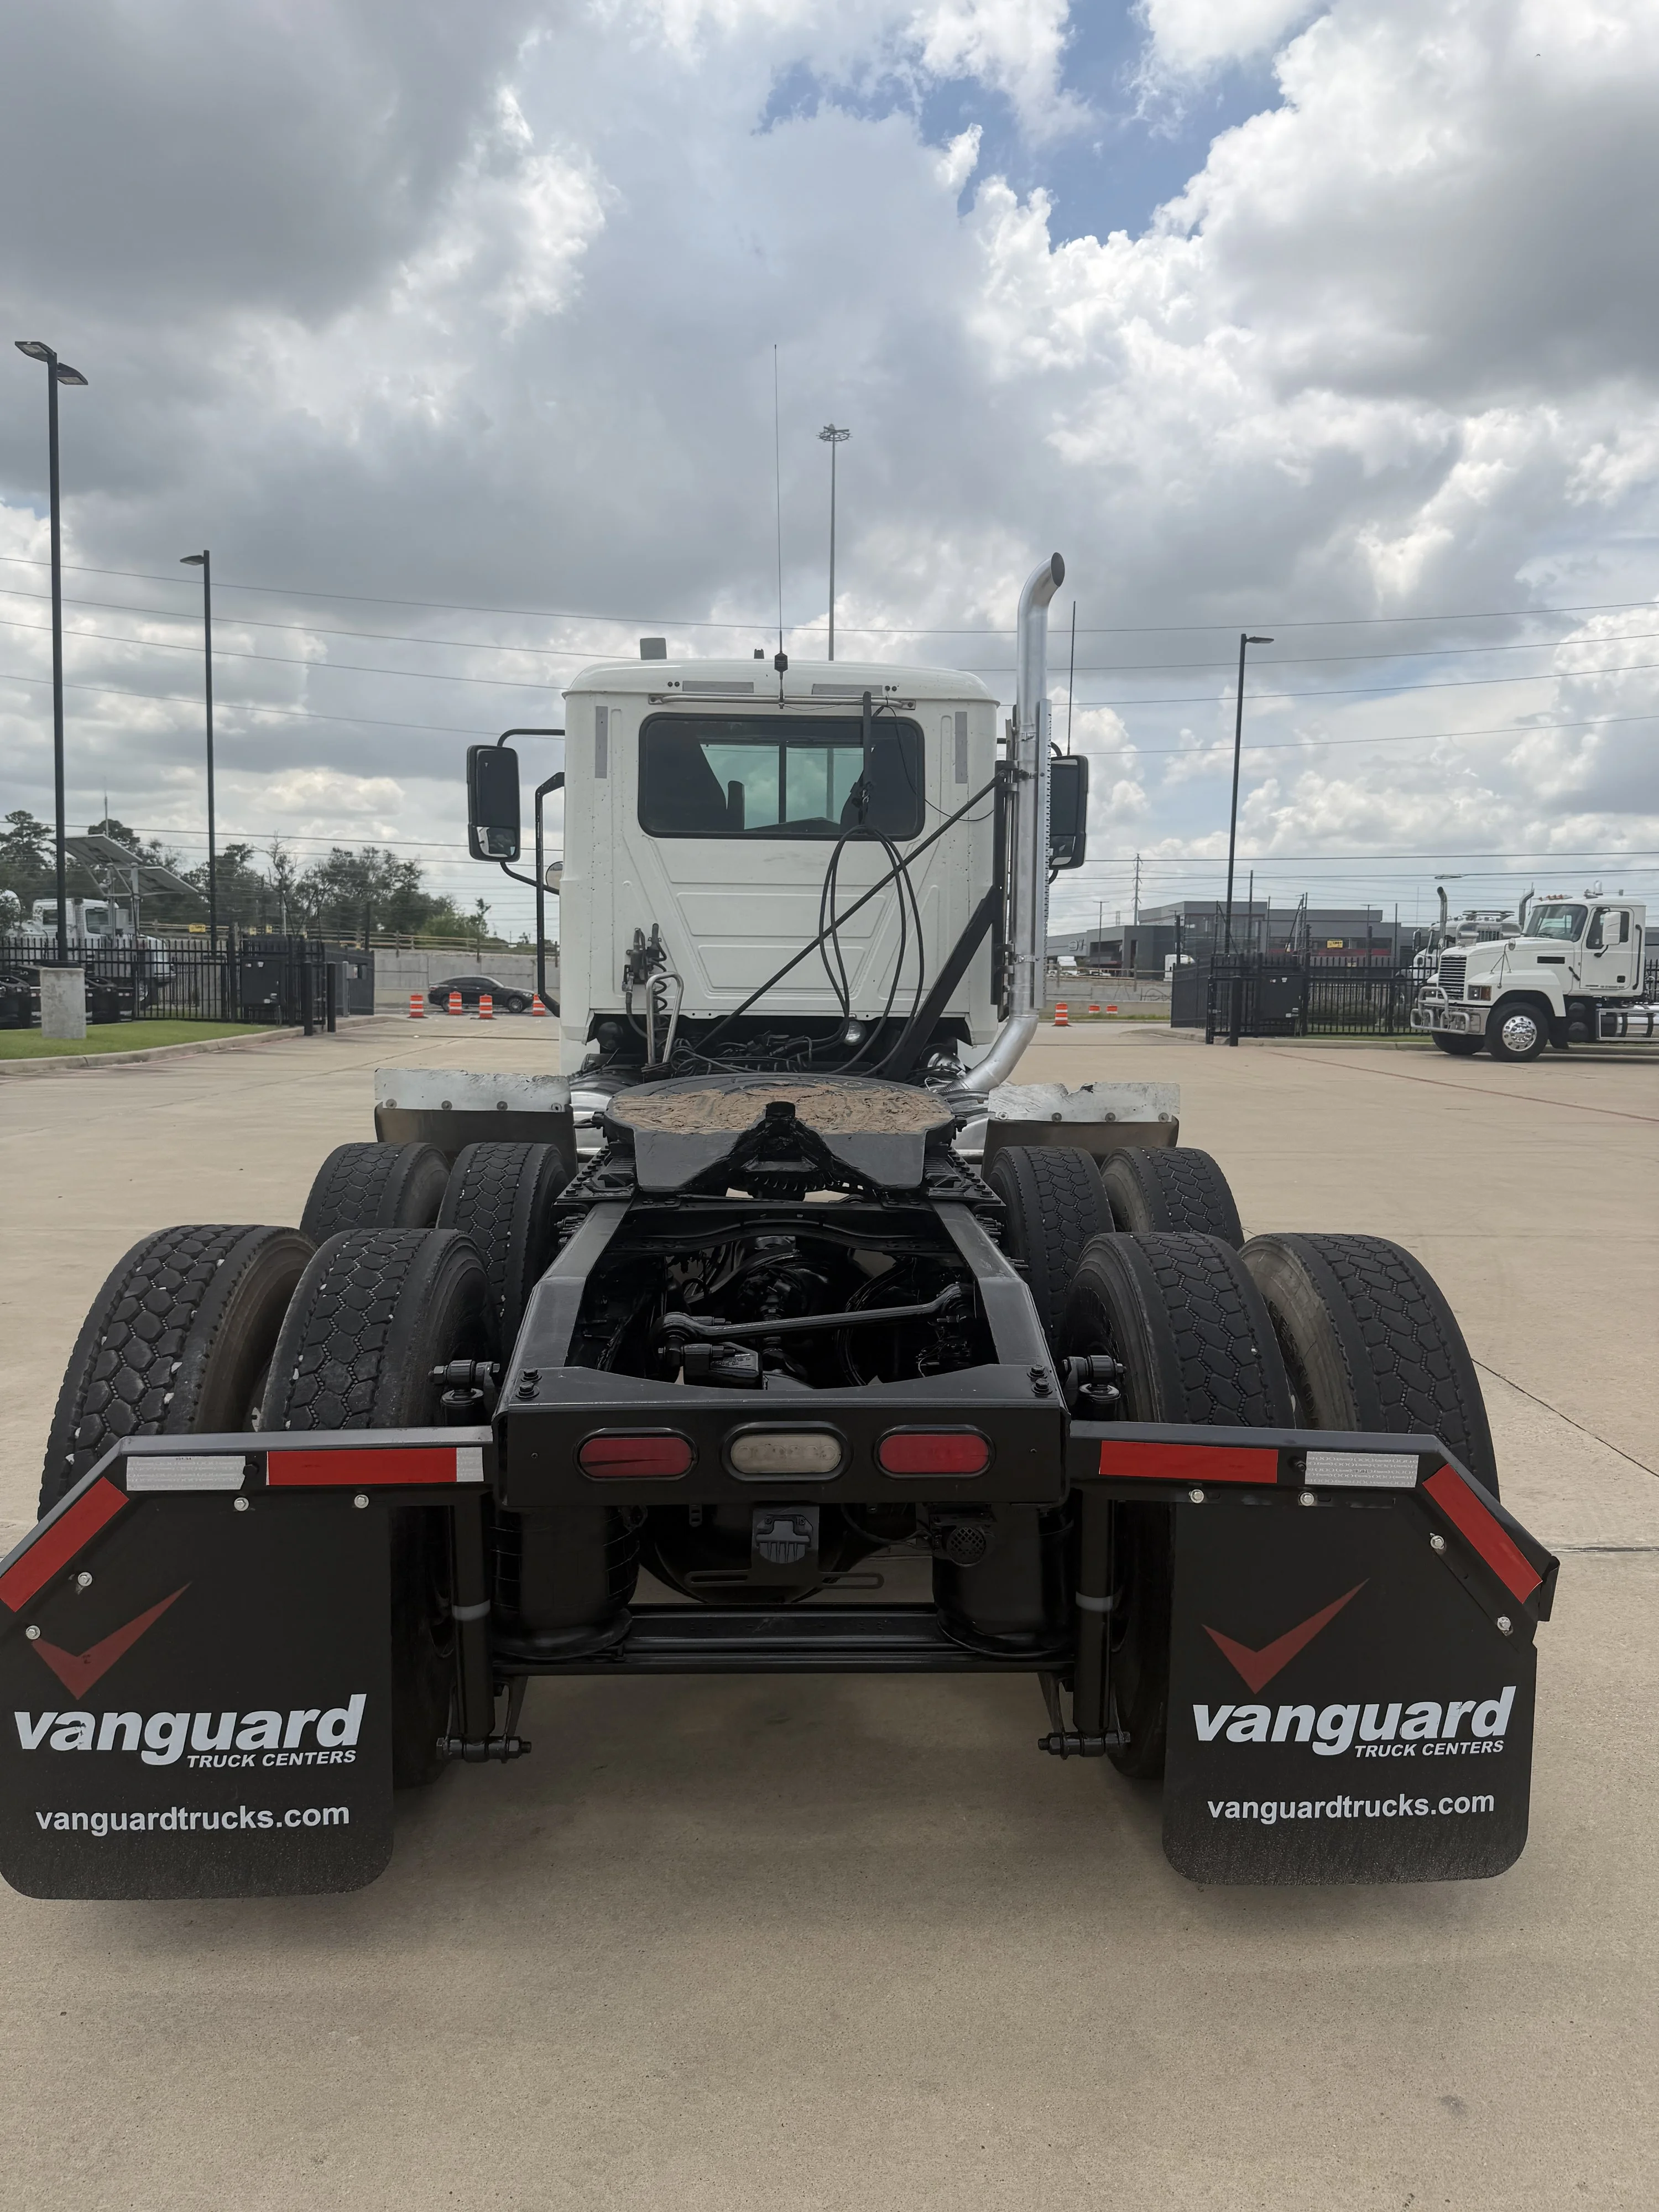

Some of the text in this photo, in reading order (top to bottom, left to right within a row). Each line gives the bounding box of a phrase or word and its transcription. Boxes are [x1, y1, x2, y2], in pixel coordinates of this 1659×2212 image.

[14, 1693, 367, 1766] vanguard
[1192, 1686, 1517, 1756] vanguard
[187, 1750, 356, 1768] TRUCK CENTERS
[1354, 1740, 1504, 1757] TRUCK CENTERS
[35, 1805, 349, 1837] vanguardtrucks.com
[1207, 1793, 1494, 1825] vanguardtrucks.com
